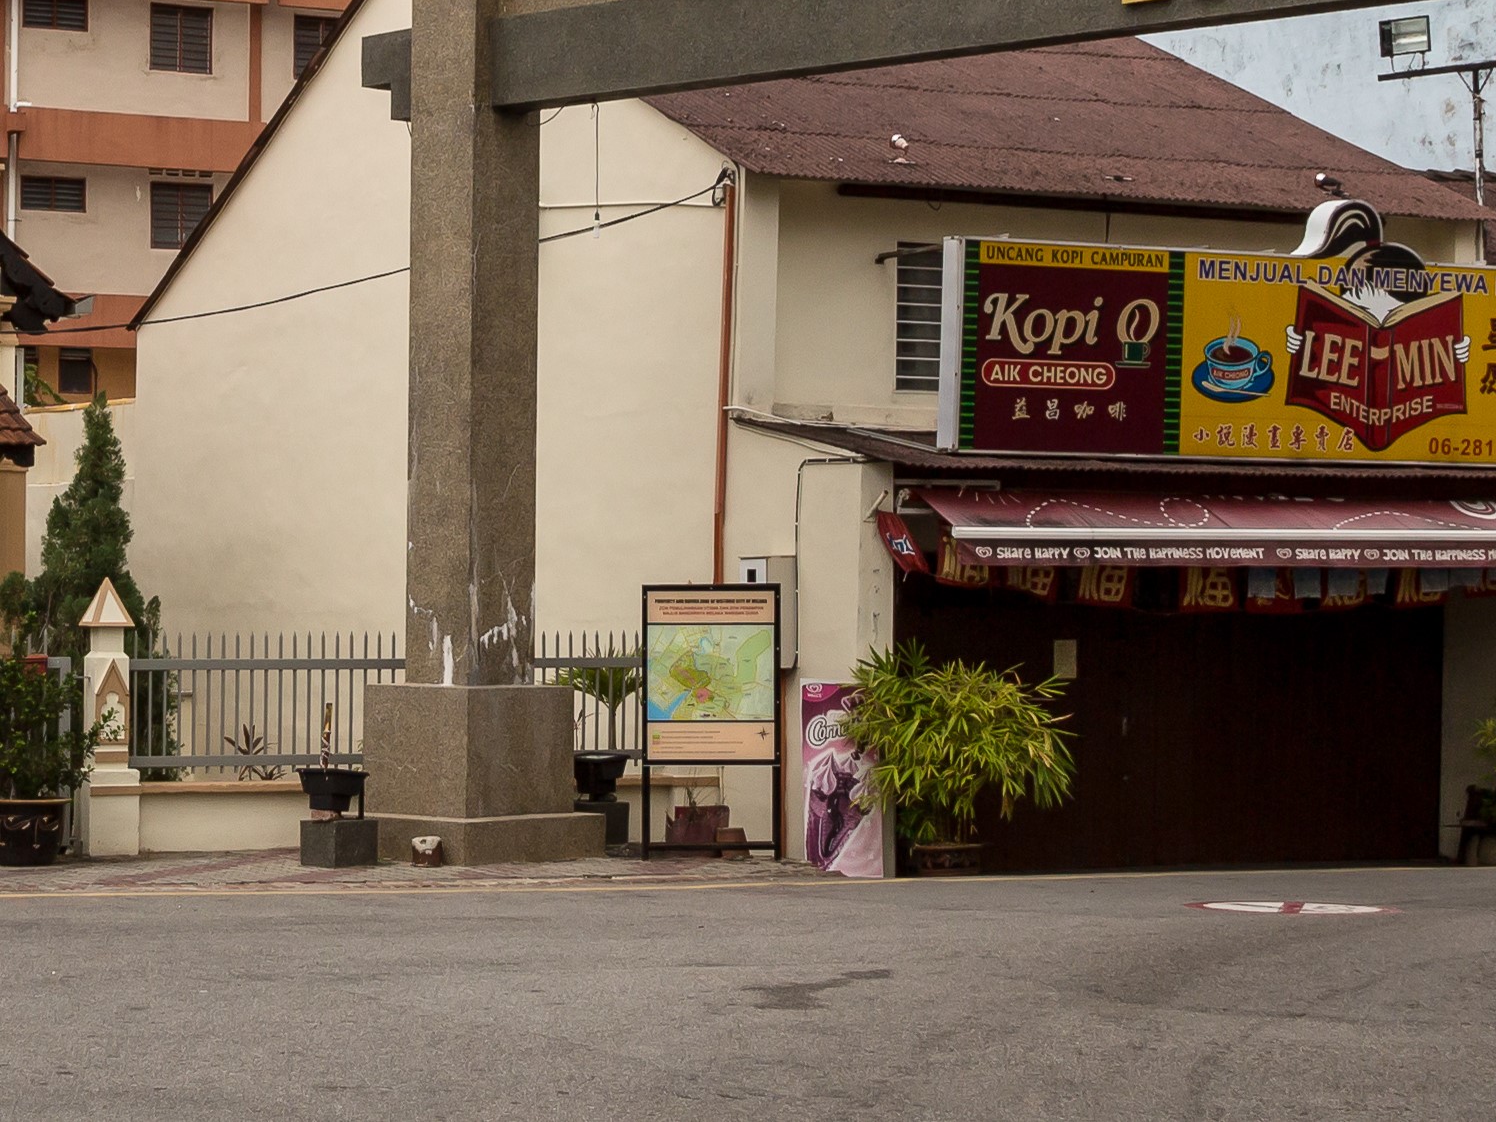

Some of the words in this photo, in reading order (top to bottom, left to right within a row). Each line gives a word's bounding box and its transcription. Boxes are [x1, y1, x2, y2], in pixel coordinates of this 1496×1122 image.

[986, 245, 1044, 263] UNCANG
[1051, 249, 1083, 265] KOPI
[1091, 250, 1164, 268] CAMPURAN
[1198, 258, 1306, 284] MENJUAL
[1317, 265, 1368, 288] DAN
[1374, 267, 1489, 295] MENYEWA
[983, 292, 1104, 355] Kopi
[990, 364, 1021, 381] AIK
[1029, 365, 1107, 385] CHEONG
[1012, 397, 1127, 422] 益昌咖啡
[1330, 392, 1434, 427] ENTERPRISE
[1428, 437, 1493, 457] 06-281
